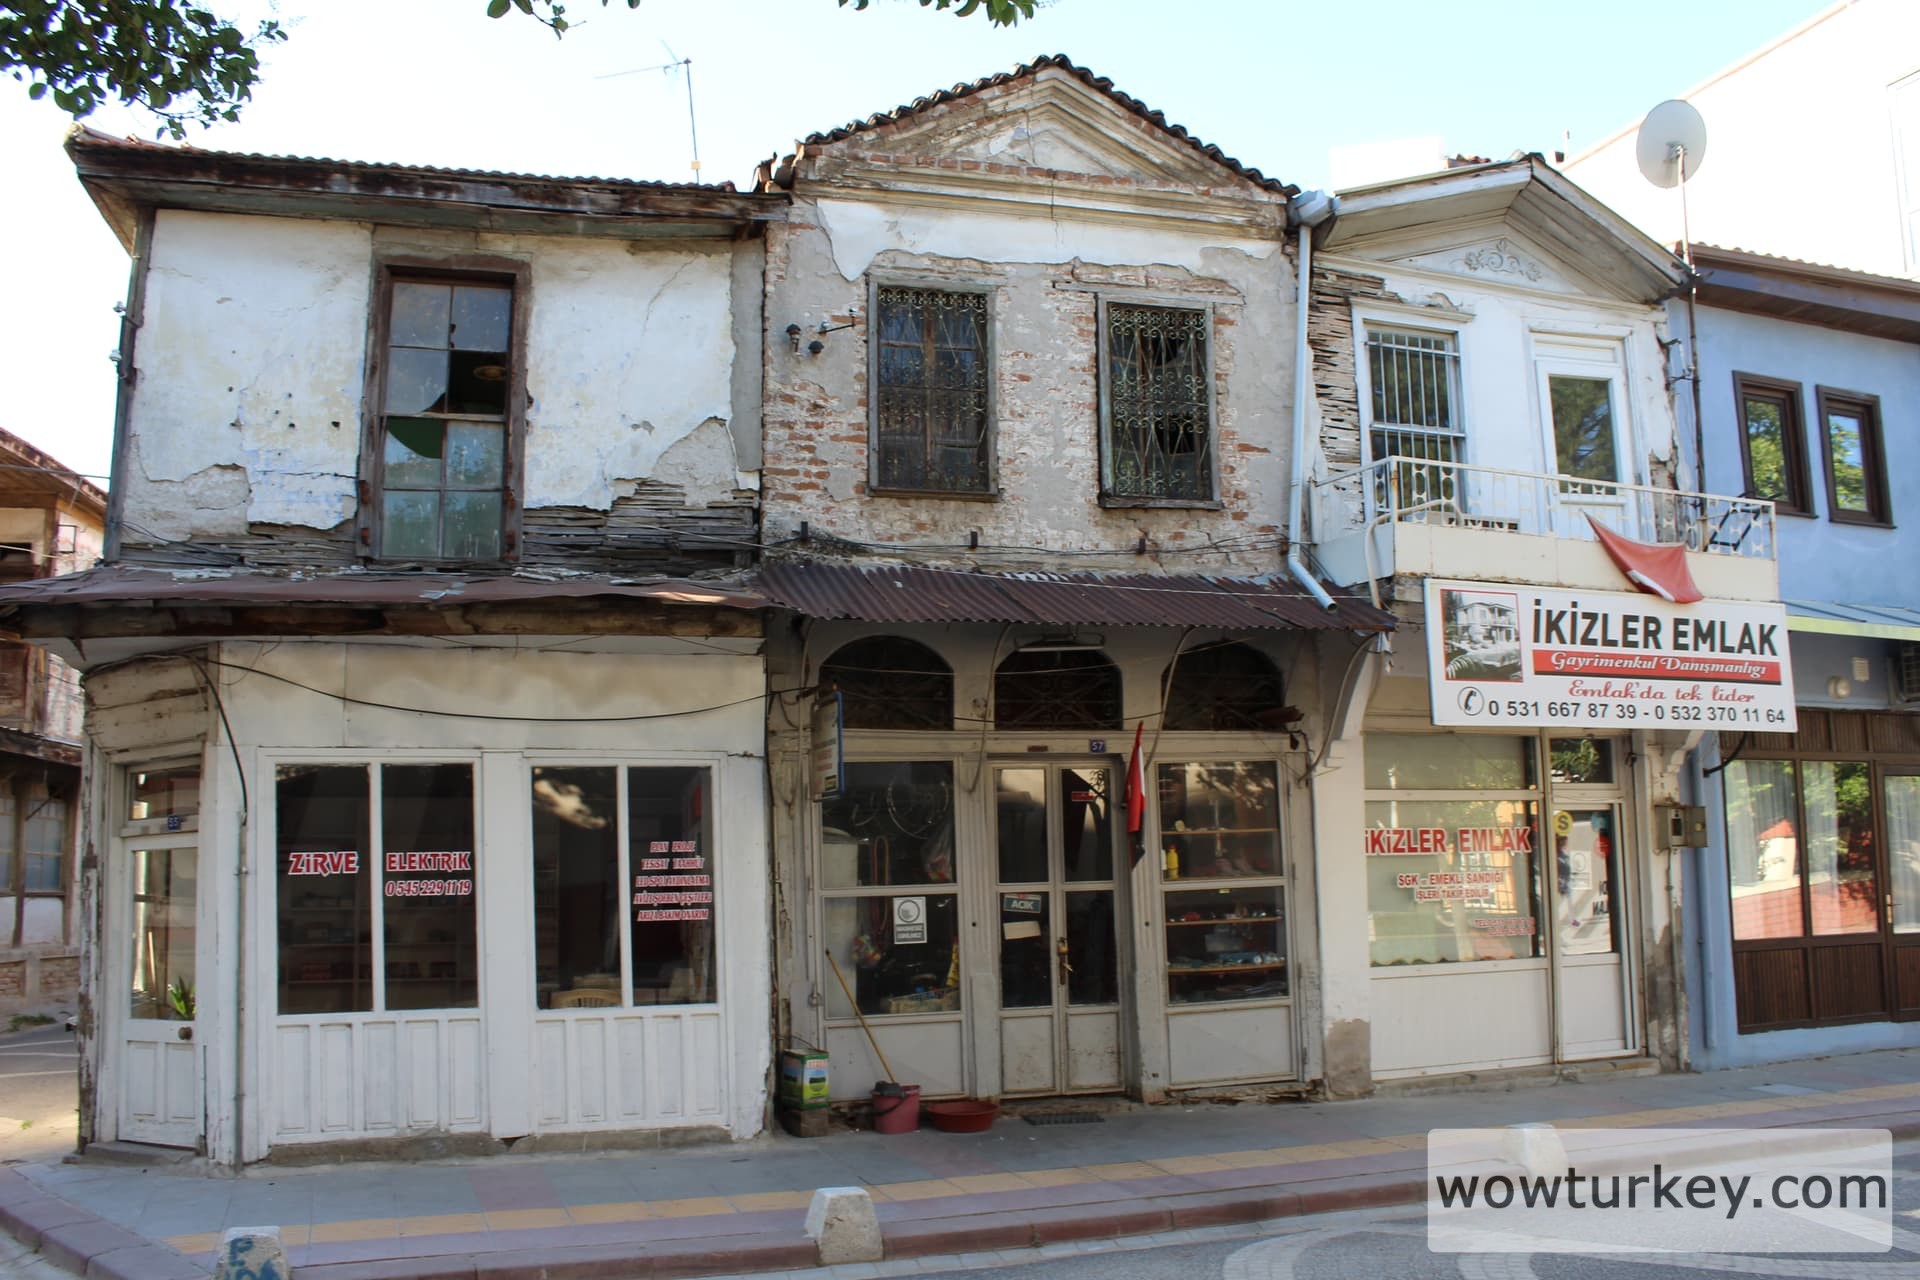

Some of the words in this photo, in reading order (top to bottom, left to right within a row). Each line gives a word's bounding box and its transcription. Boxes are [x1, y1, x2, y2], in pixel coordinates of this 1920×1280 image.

[1532, 598, 1663, 650] İKİZLER
[1672, 617, 1778, 657] EMLAK
[1551, 651, 1657, 671] Gayrimenkul
[1569, 679, 1666, 701] Emlak'da
[1675, 684, 1703, 701] tek
[1711, 685, 1755, 702] lider
[1488, 700, 1500, 717] 0
[1507, 700, 1540, 717] 531
[1548, 702, 1581, 717] 667
[1587, 703, 1609, 718] 87
[1615, 704, 1637, 719] 39
[1655, 705, 1665, 720] 0
[1671, 706, 1702, 721] 532
[1707, 706, 1737, 722] 370
[1743, 708, 1759, 722] 11
[1766, 709, 1785, 723] 64
[1092, 741, 1104, 752] 57
[1557, 815, 1569, 831] S
[1458, 827, 1532, 852] EMLAK
[386, 881, 395, 895] 0
[397, 881, 418, 895] 545
[420, 880, 443, 895] 229
[445, 880, 456, 895] 11
[458, 880, 472, 895] 19
[1398, 874, 1418, 886] SGK
